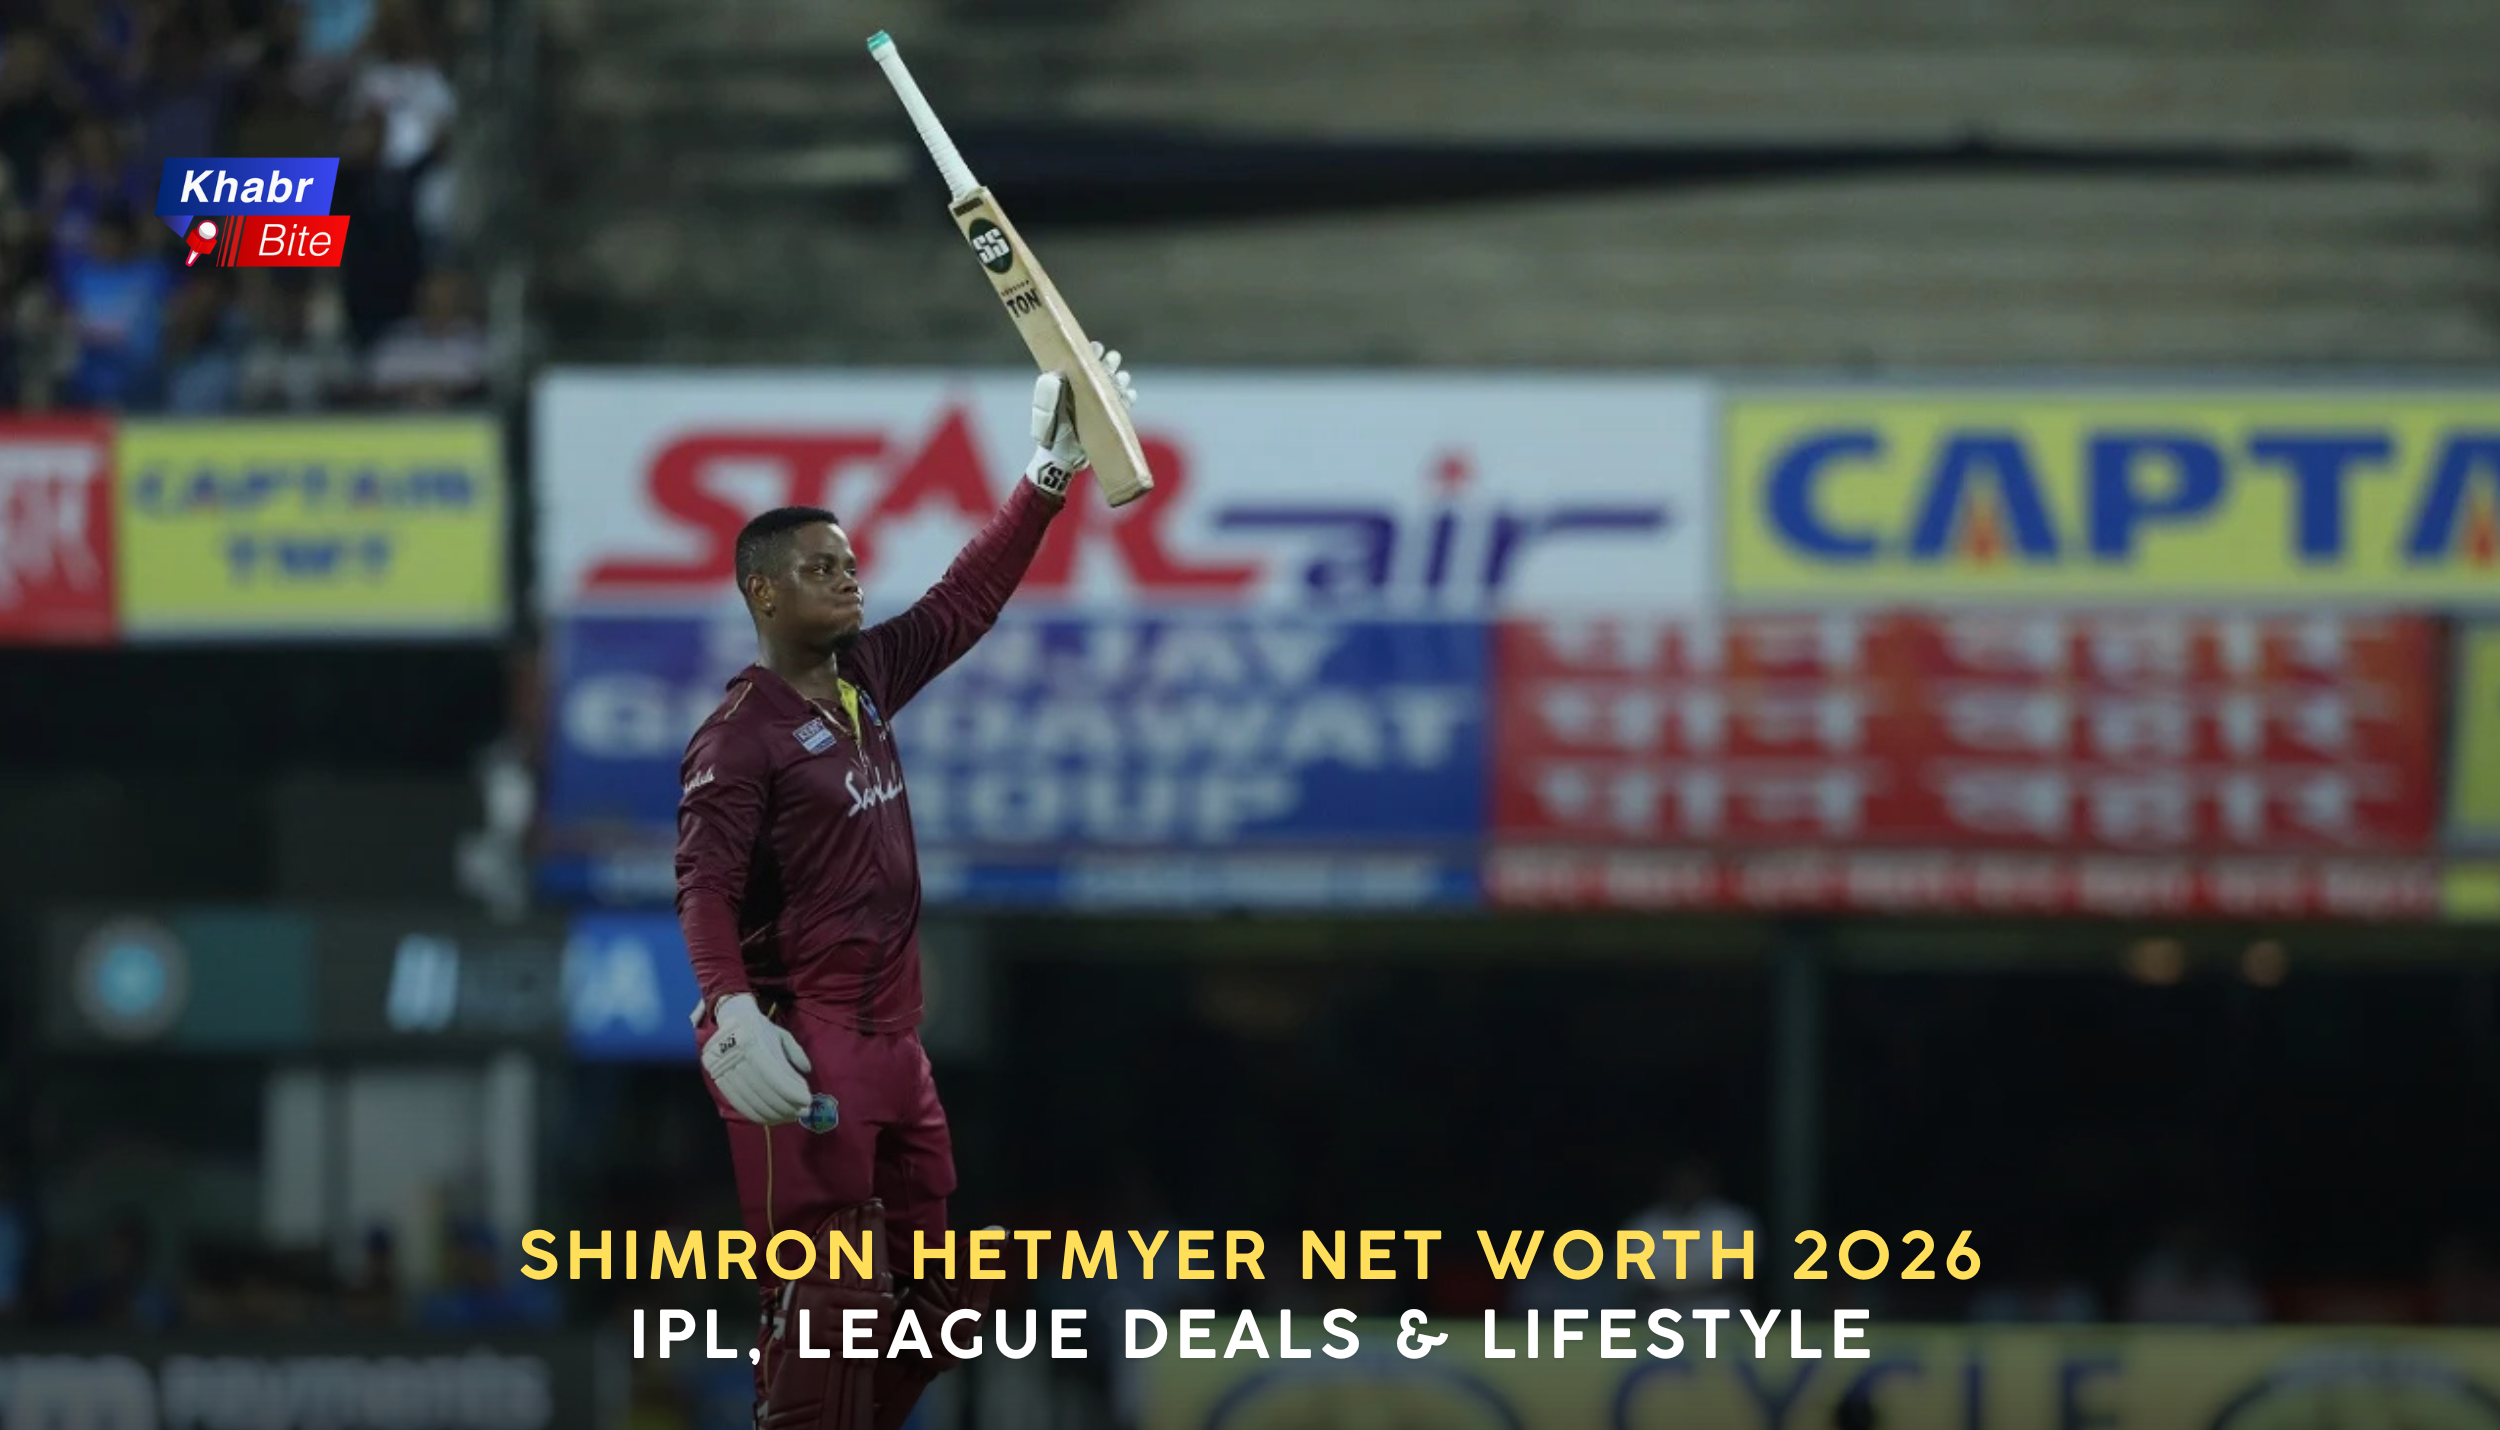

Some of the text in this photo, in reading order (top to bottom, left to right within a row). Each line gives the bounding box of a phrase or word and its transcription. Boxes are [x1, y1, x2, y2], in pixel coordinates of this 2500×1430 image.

[973, 227, 1010, 264] SS
[1006, 287, 1042, 318] TON
[1210, 450, 1675, 602] air
